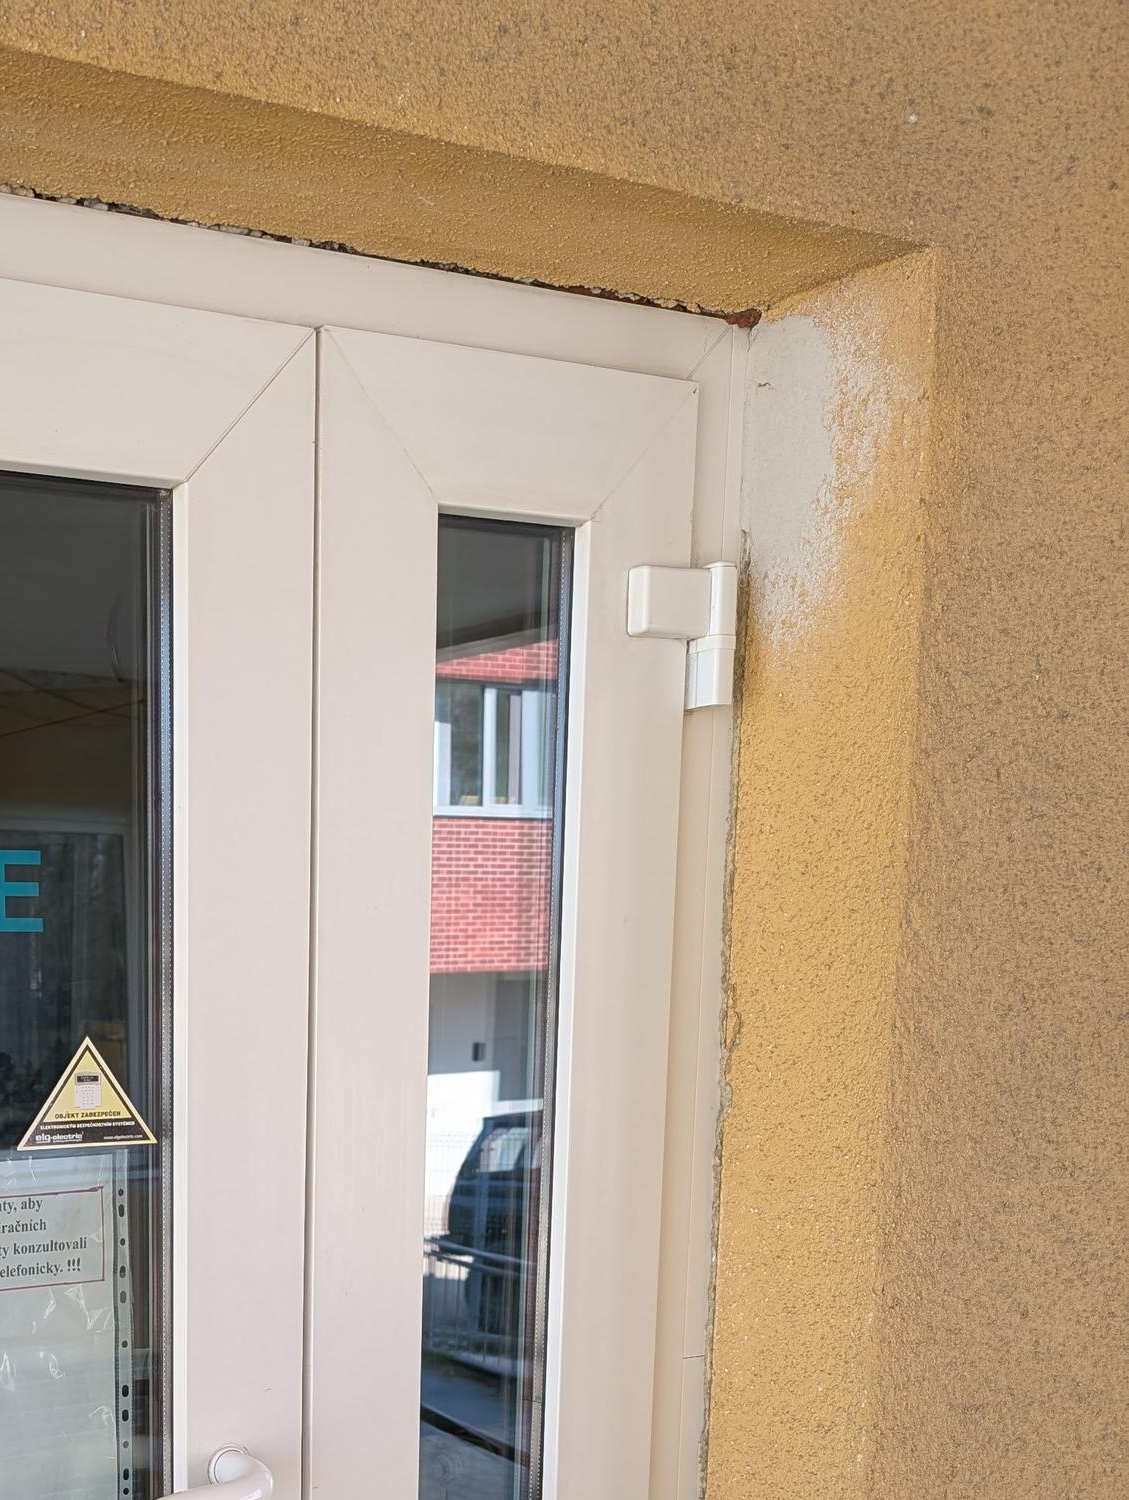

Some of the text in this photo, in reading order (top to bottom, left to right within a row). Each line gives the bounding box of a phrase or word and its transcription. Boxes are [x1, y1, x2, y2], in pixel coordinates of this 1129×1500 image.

[21, 1197, 43, 1213] aby
[13, 1237, 87, 1255] konzultovali
[67, 1258, 81, 1272] !!!
